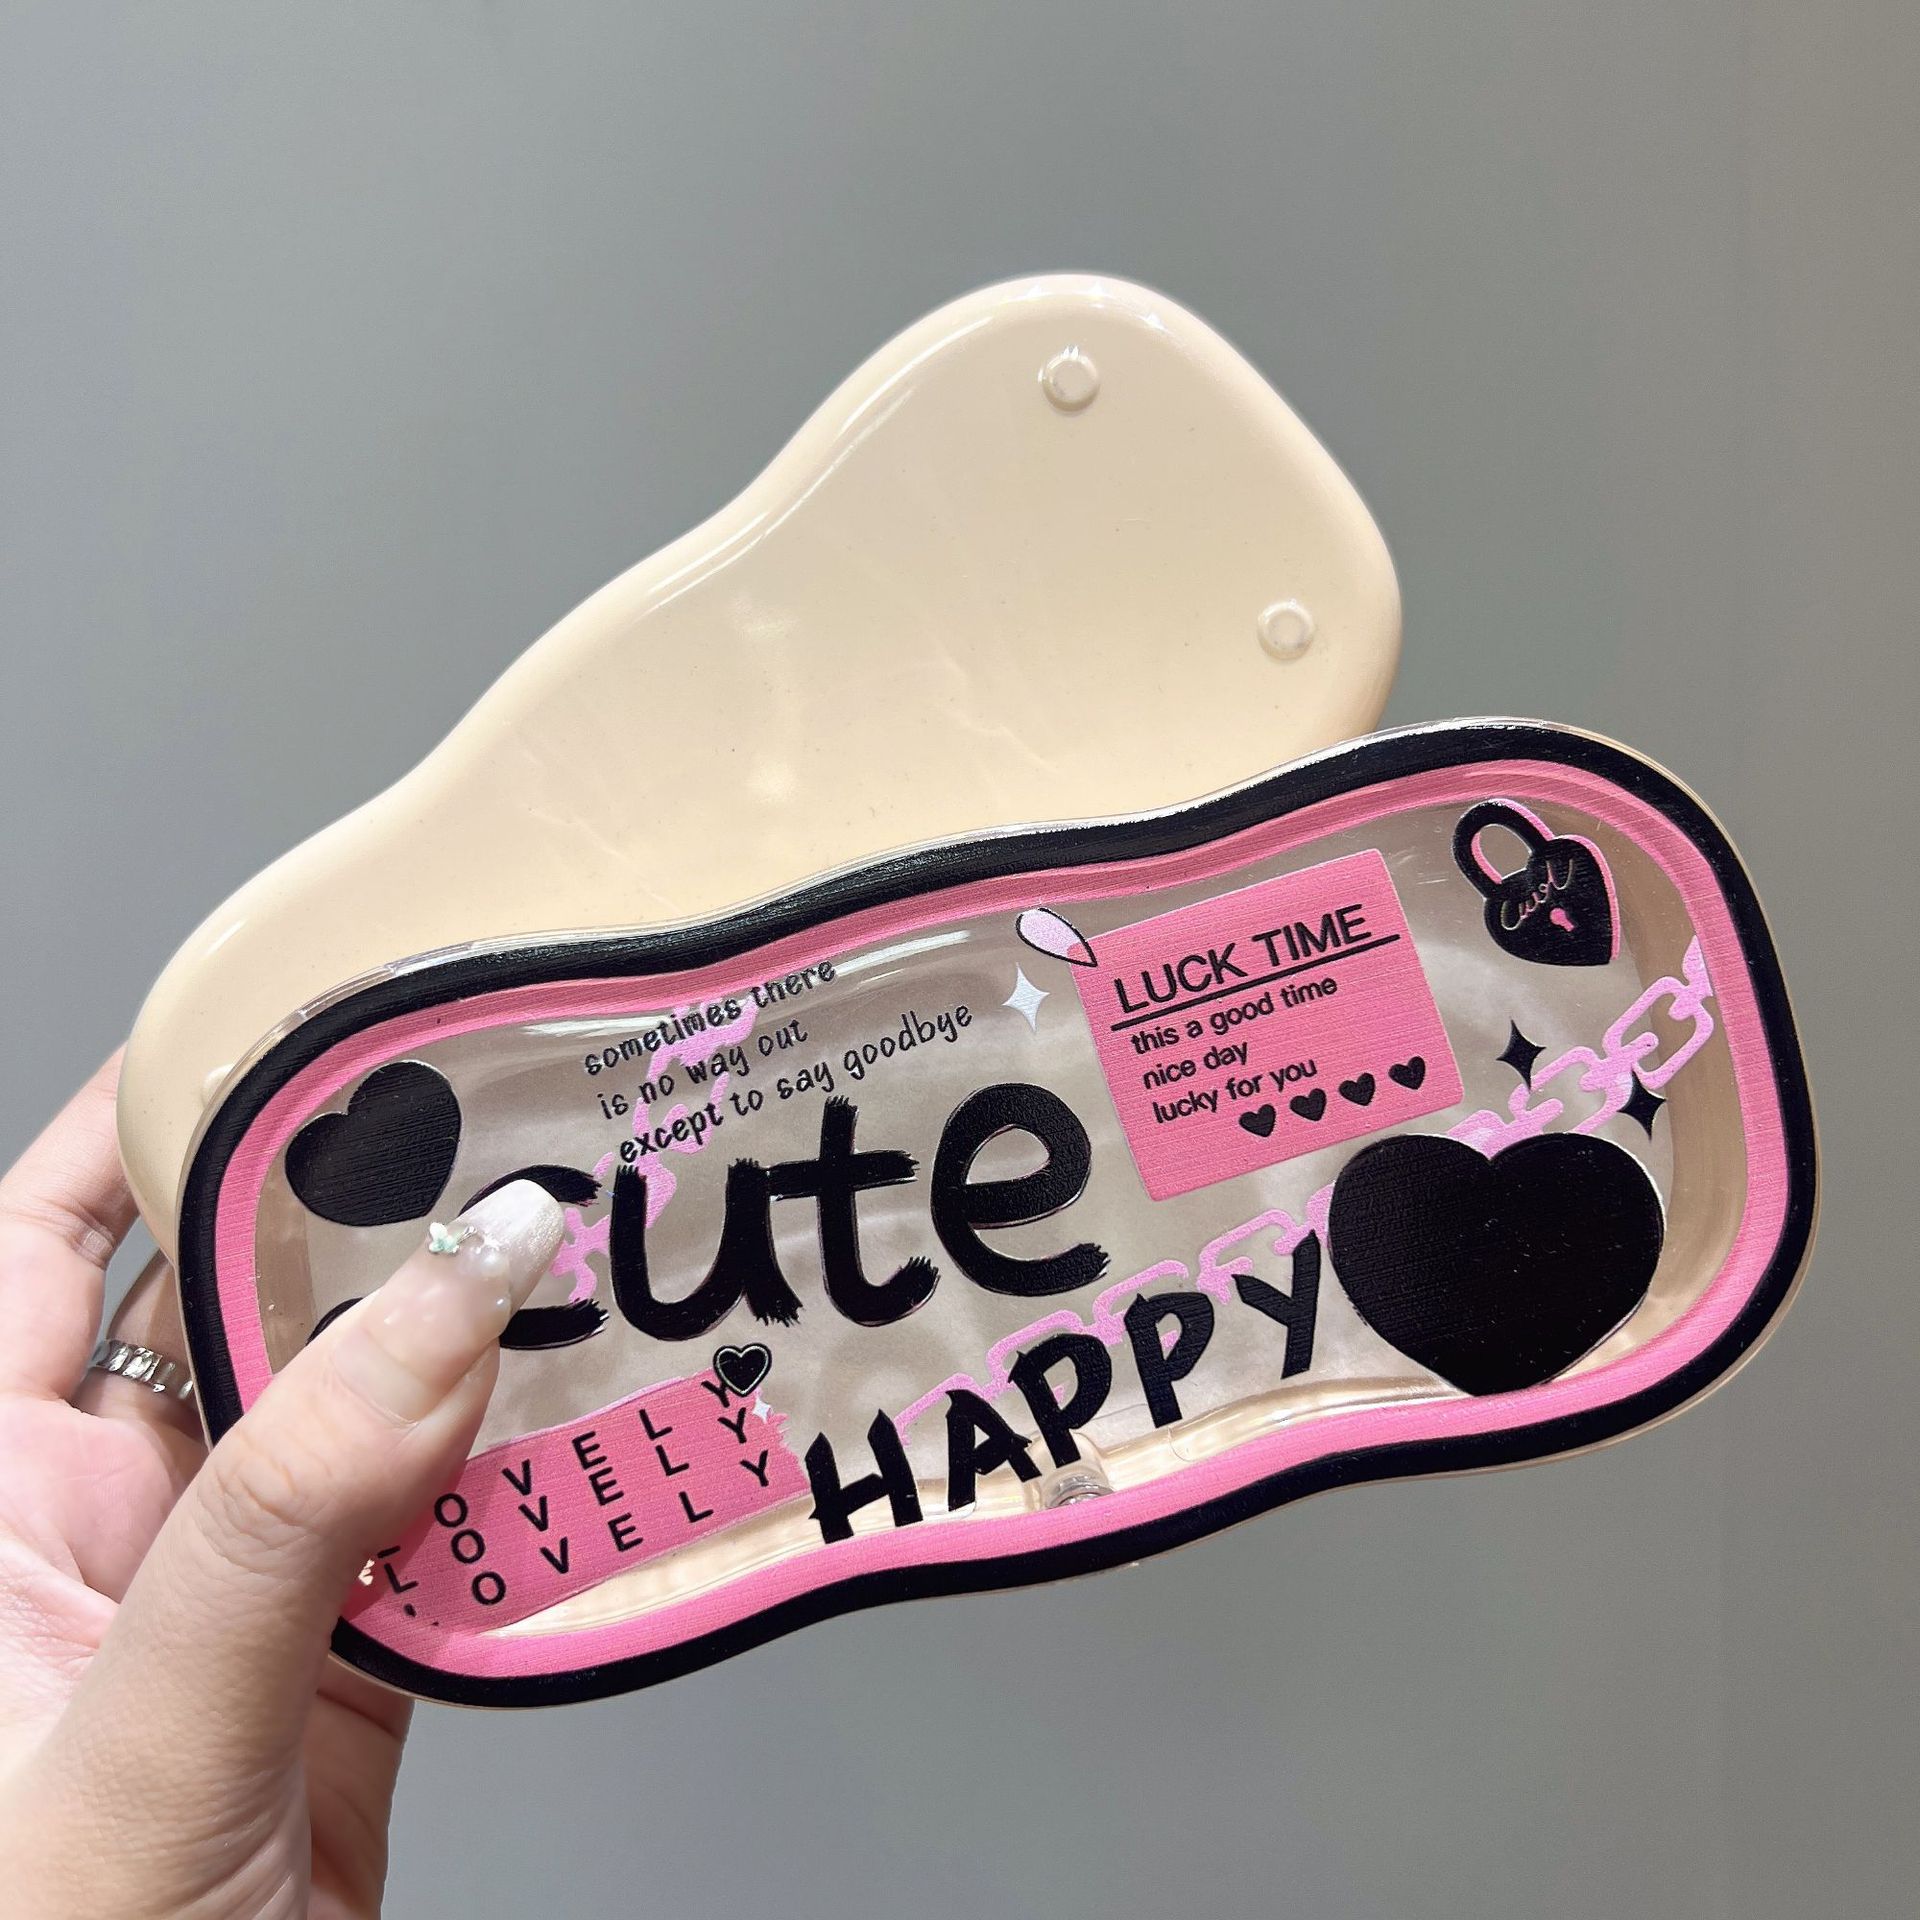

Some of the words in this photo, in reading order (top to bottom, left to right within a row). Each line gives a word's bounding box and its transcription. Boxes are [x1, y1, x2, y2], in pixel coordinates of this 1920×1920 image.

[1114, 942, 1248, 1013] LUCK
[1252, 903, 1372, 967] TIME
[585, 995, 742, 1076] sometimes
[750, 959, 836, 1008] there
[597, 1092, 629, 1120] is
[638, 1074, 675, 1105] no
[685, 1046, 751, 1085] way
[758, 1018, 808, 1056] out
[1131, 1026, 1180, 1055] this
[1185, 1020, 1204, 1039] a
[1210, 992, 1275, 1035] good
[1280, 977, 1338, 1008] time
[1143, 1059, 1197, 1090] nice
[1203, 1041, 1249, 1070] day
[619, 1103, 724, 1164] except
[730, 1088, 765, 1116] to
[776, 1061, 835, 1100] say
[843, 1003, 973, 1080] goodbye
[1152, 1089, 1218, 1123] lucky
[1225, 1074, 1263, 1100] for
[1270, 1059, 1318, 1092] you
[804, 1229, 1322, 1544] HAPPY
[403, 1449, 770, 1628] OVELY
